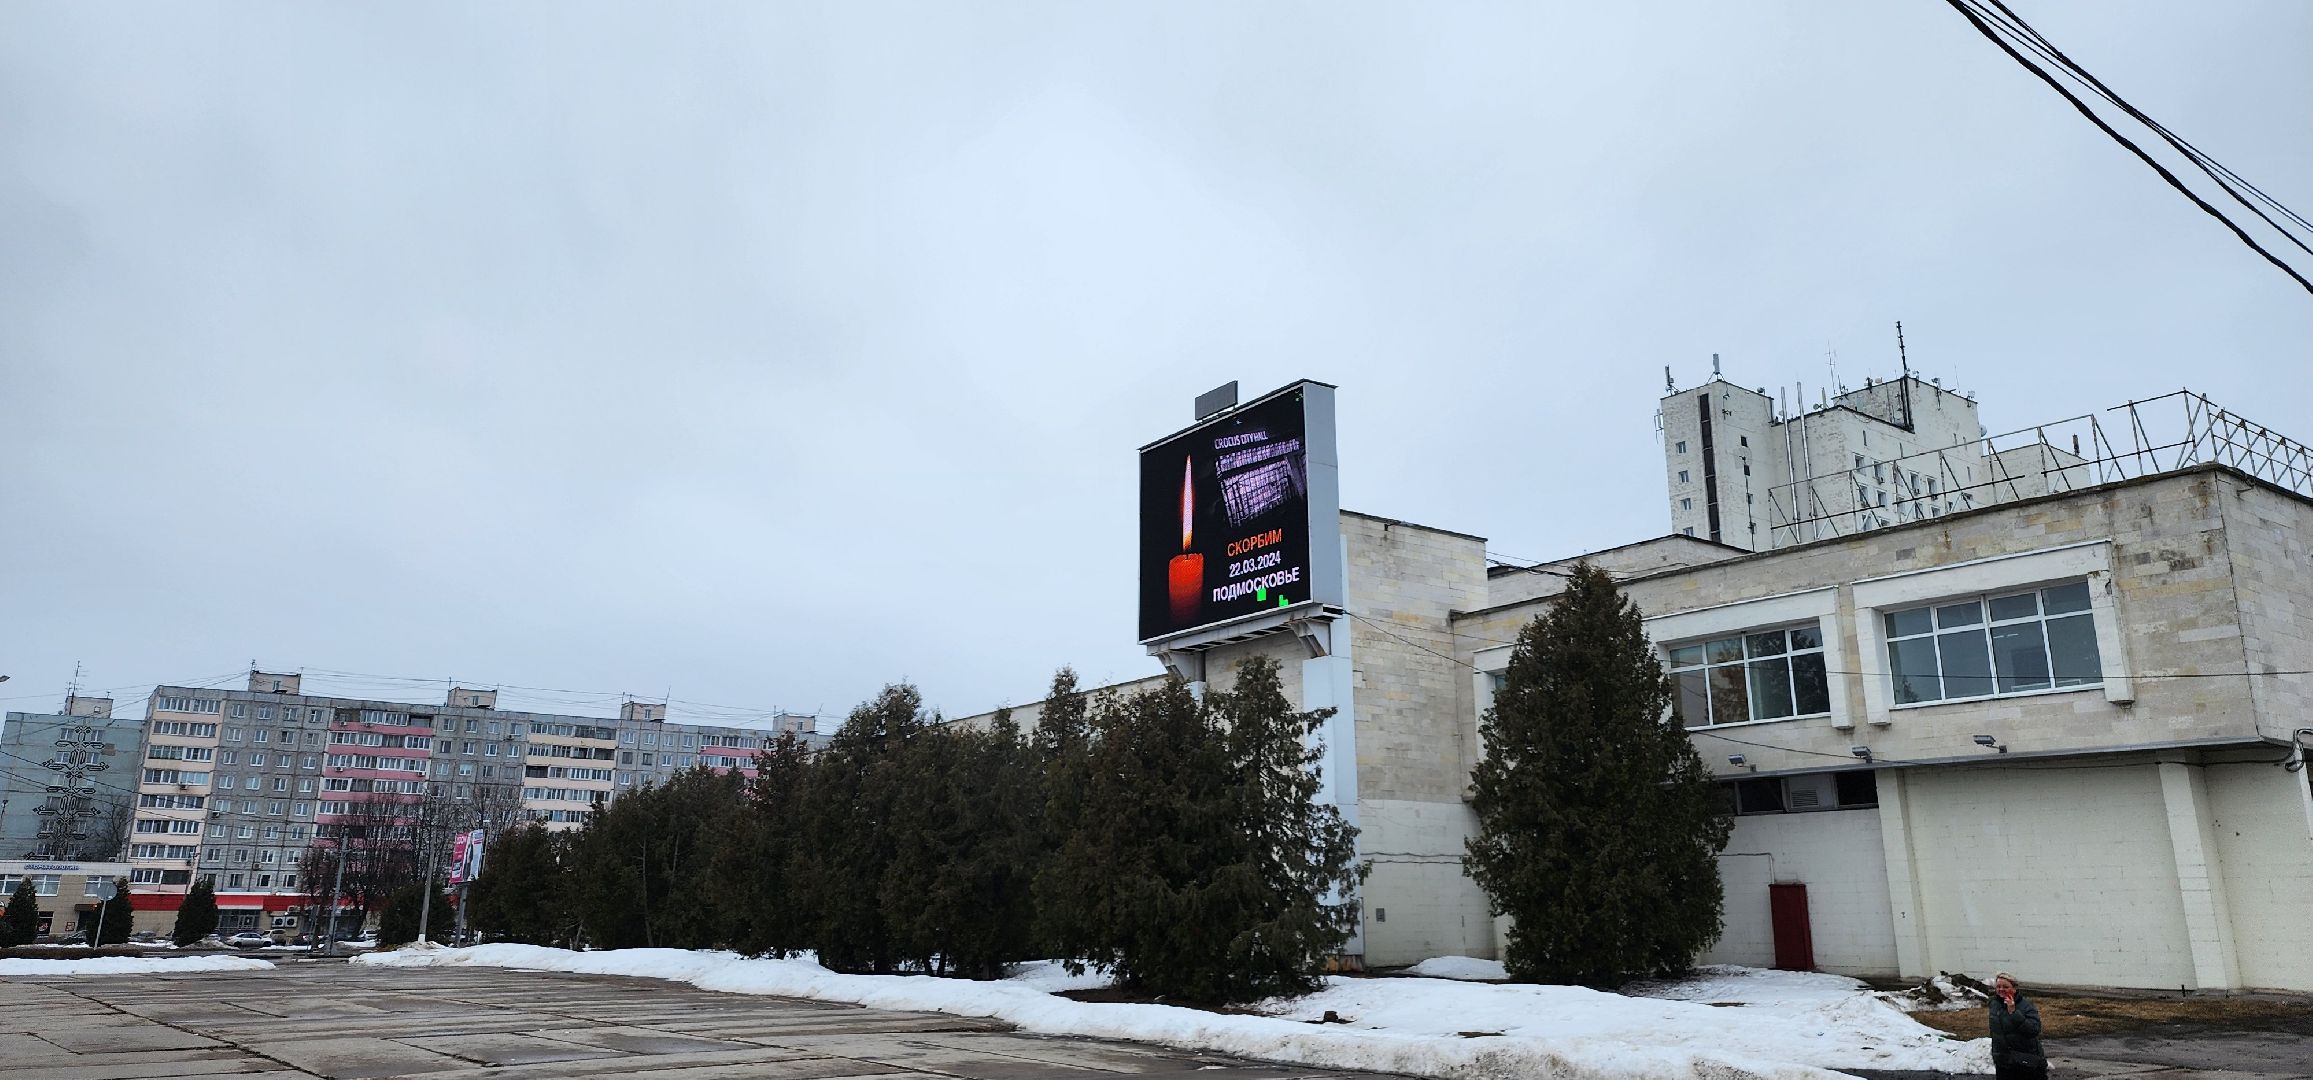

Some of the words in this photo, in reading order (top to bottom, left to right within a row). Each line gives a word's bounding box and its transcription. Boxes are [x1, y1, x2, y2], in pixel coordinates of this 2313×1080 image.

[1214, 434, 1240, 450] CROCUS
[1240, 432, 1254, 445] CITY
[1252, 430, 1268, 442] HALL
[1227, 528, 1282, 557] СКОРБИМ
[1229, 550, 1281, 578] 22.03.2024
[1213, 566, 1300, 602] ПОДМОСКОВЬЕ
